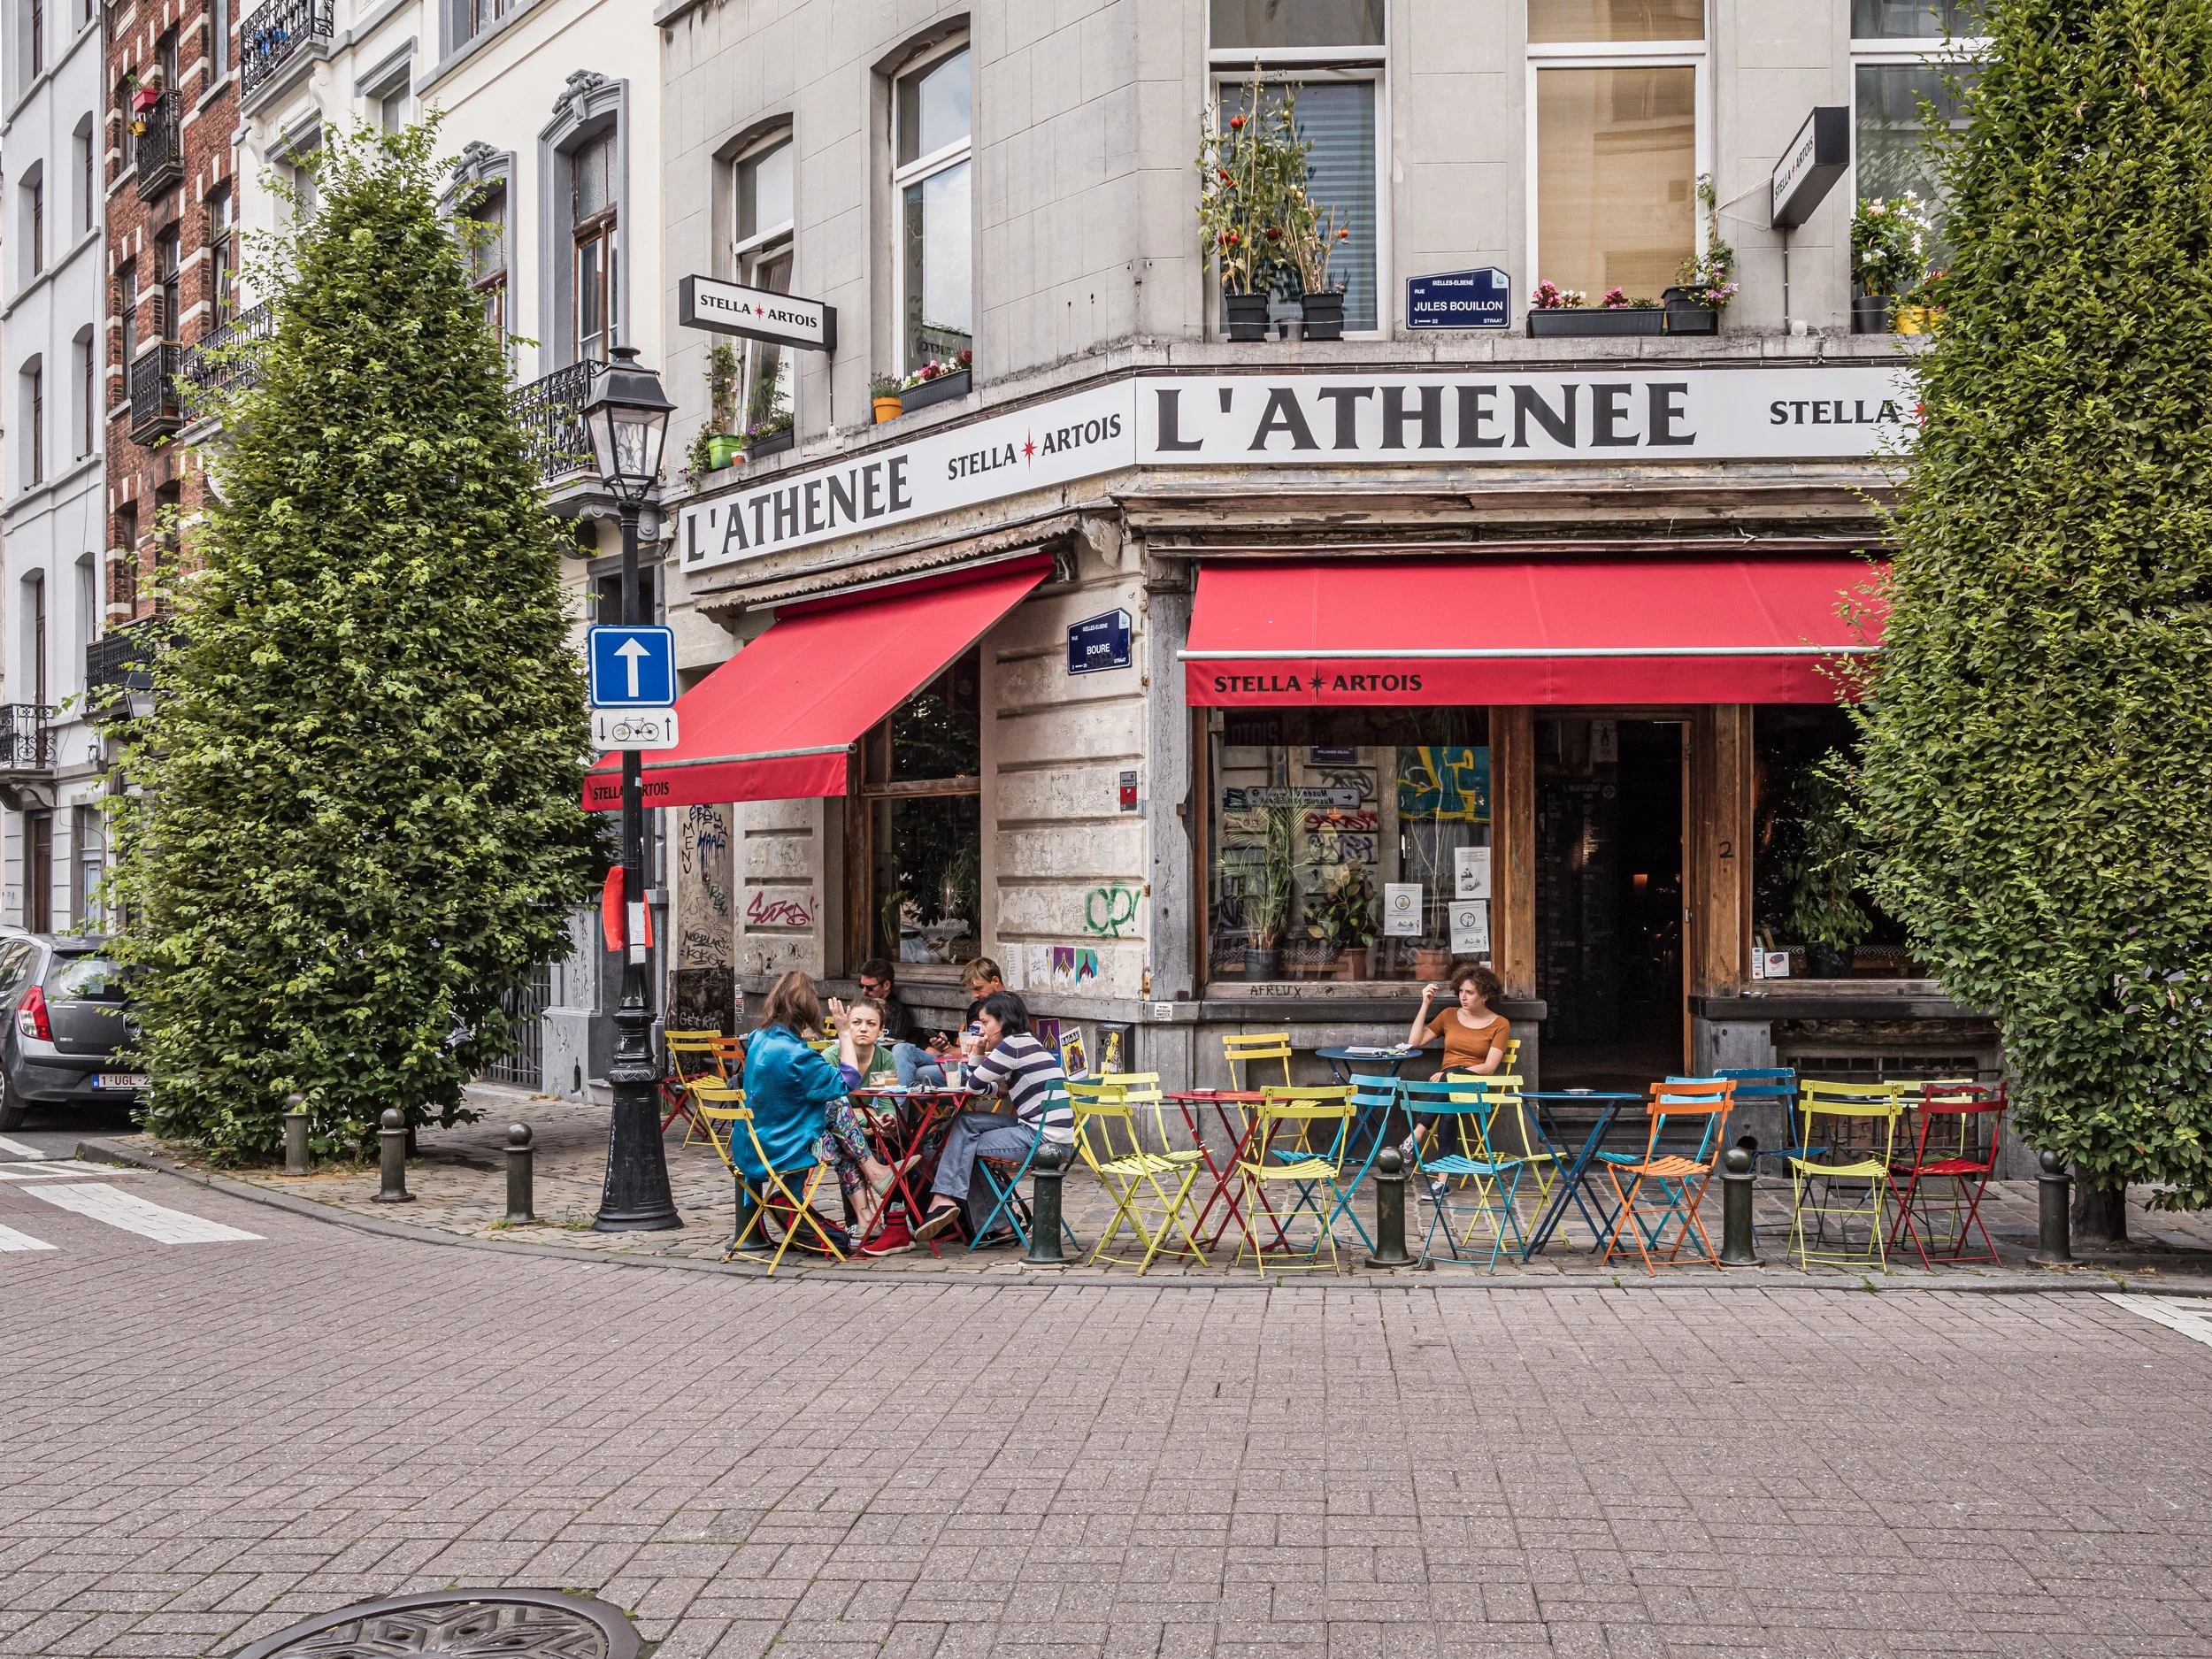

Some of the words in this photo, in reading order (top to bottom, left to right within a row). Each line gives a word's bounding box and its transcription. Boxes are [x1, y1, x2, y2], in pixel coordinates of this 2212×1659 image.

[1775, 170, 1791, 200] STELLA
[1796, 135, 1813, 170] ARTOIS
[700, 295, 751, 315] STELLA
[767, 309, 818, 328] ARTOIS
[1414, 302, 1447, 311] JULES
[1450, 301, 1503, 311] BOUILLON
[1155, 382, 1697, 452] L'ATHENEE
[1770, 399, 1901, 426] STELLA
[948, 442, 1018, 480] STELLA
[1041, 413, 1121, 457] ARTOIS
[687, 454, 912, 563] L'ATHENEE
[1087, 643, 1110, 655] BOURE
[1214, 675, 1302, 693] STELLA
[1332, 674, 1423, 692] ARTOIS
[641, 781, 670, 796] RTOIS
[681, 822, 695, 874] MENU
[1719, 841, 1733, 858] 2
